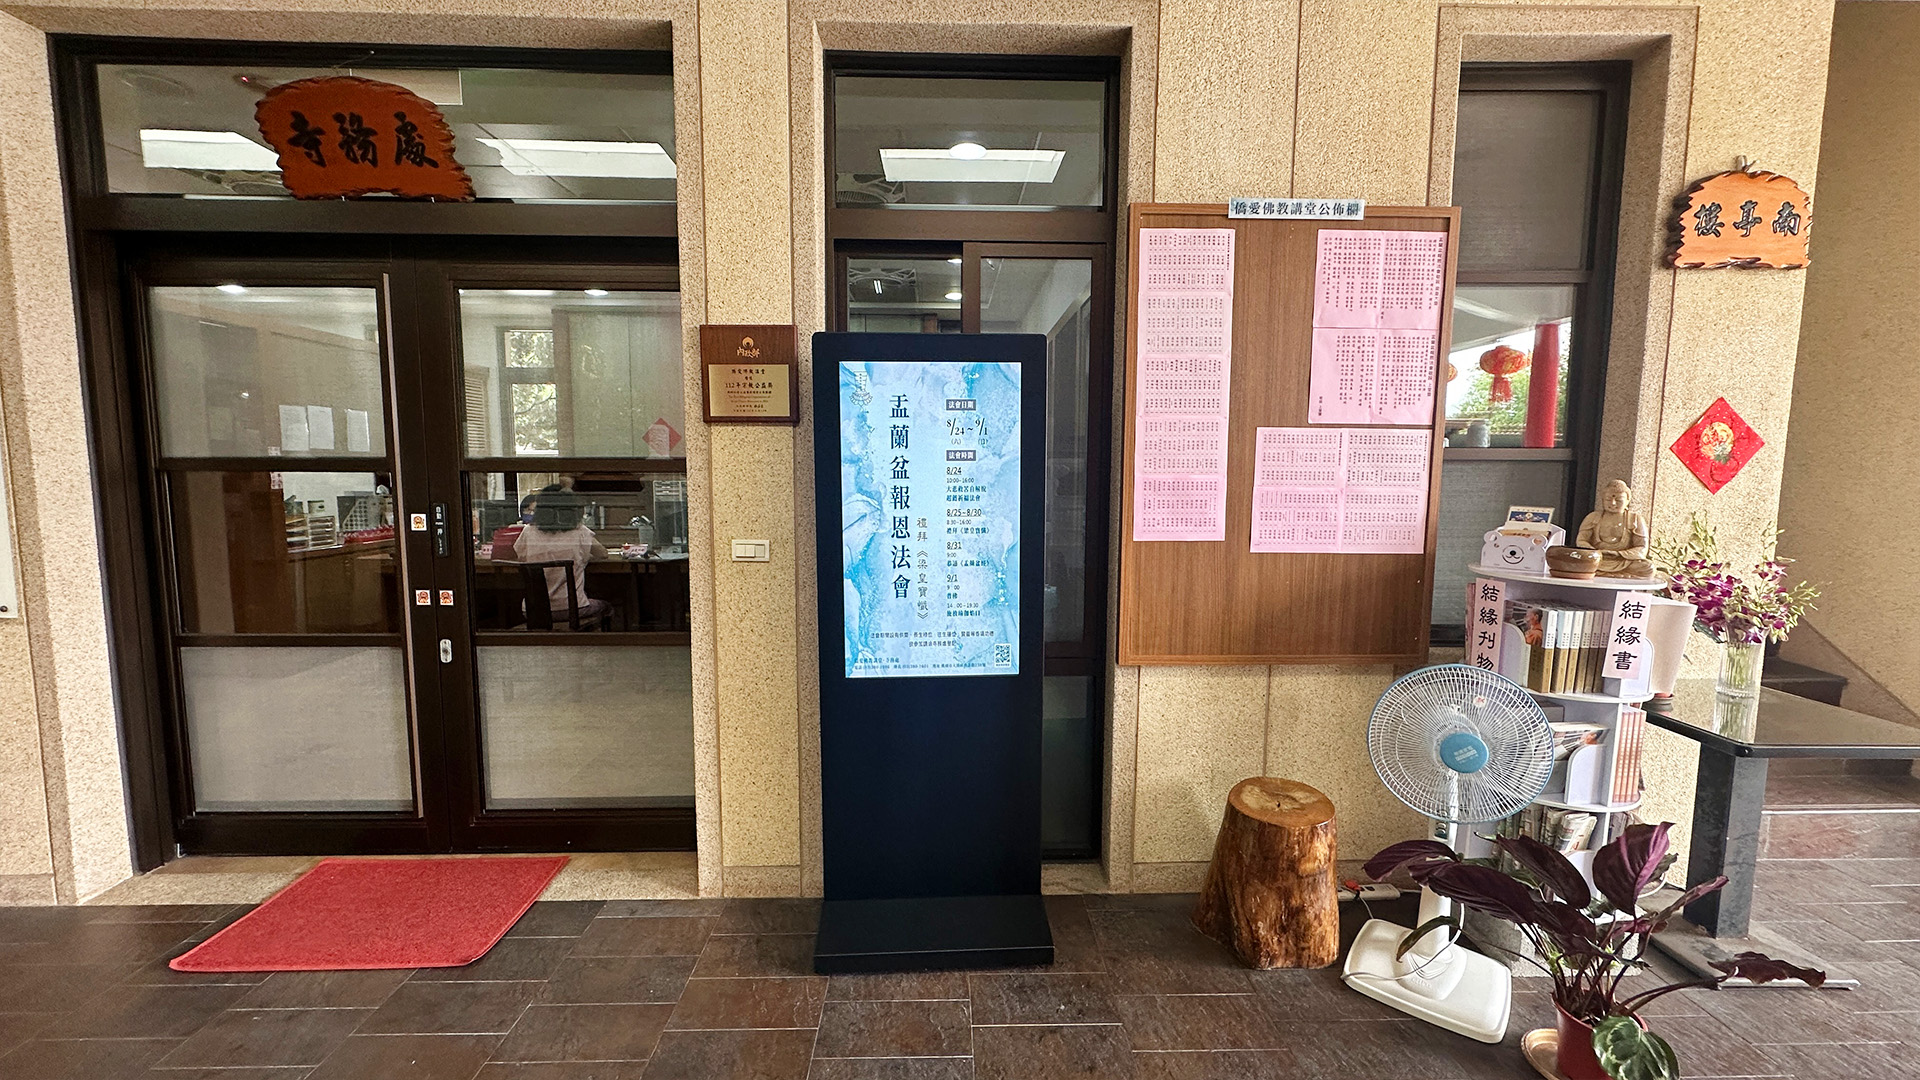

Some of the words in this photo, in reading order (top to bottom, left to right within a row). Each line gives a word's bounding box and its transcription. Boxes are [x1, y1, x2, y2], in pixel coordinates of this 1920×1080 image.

[1234, 201, 1360, 216] 僑愛佛教講堂公佈欄
[946, 466, 962, 475] 8/24
[889, 393, 911, 599] 盂蘭盆報恩法會
[946, 541, 962, 550] 8/31
[946, 574, 958, 582] 9/1
[1476, 583, 1500, 670] 結緣刊物
[1612, 600, 1647, 670] 結緣書
